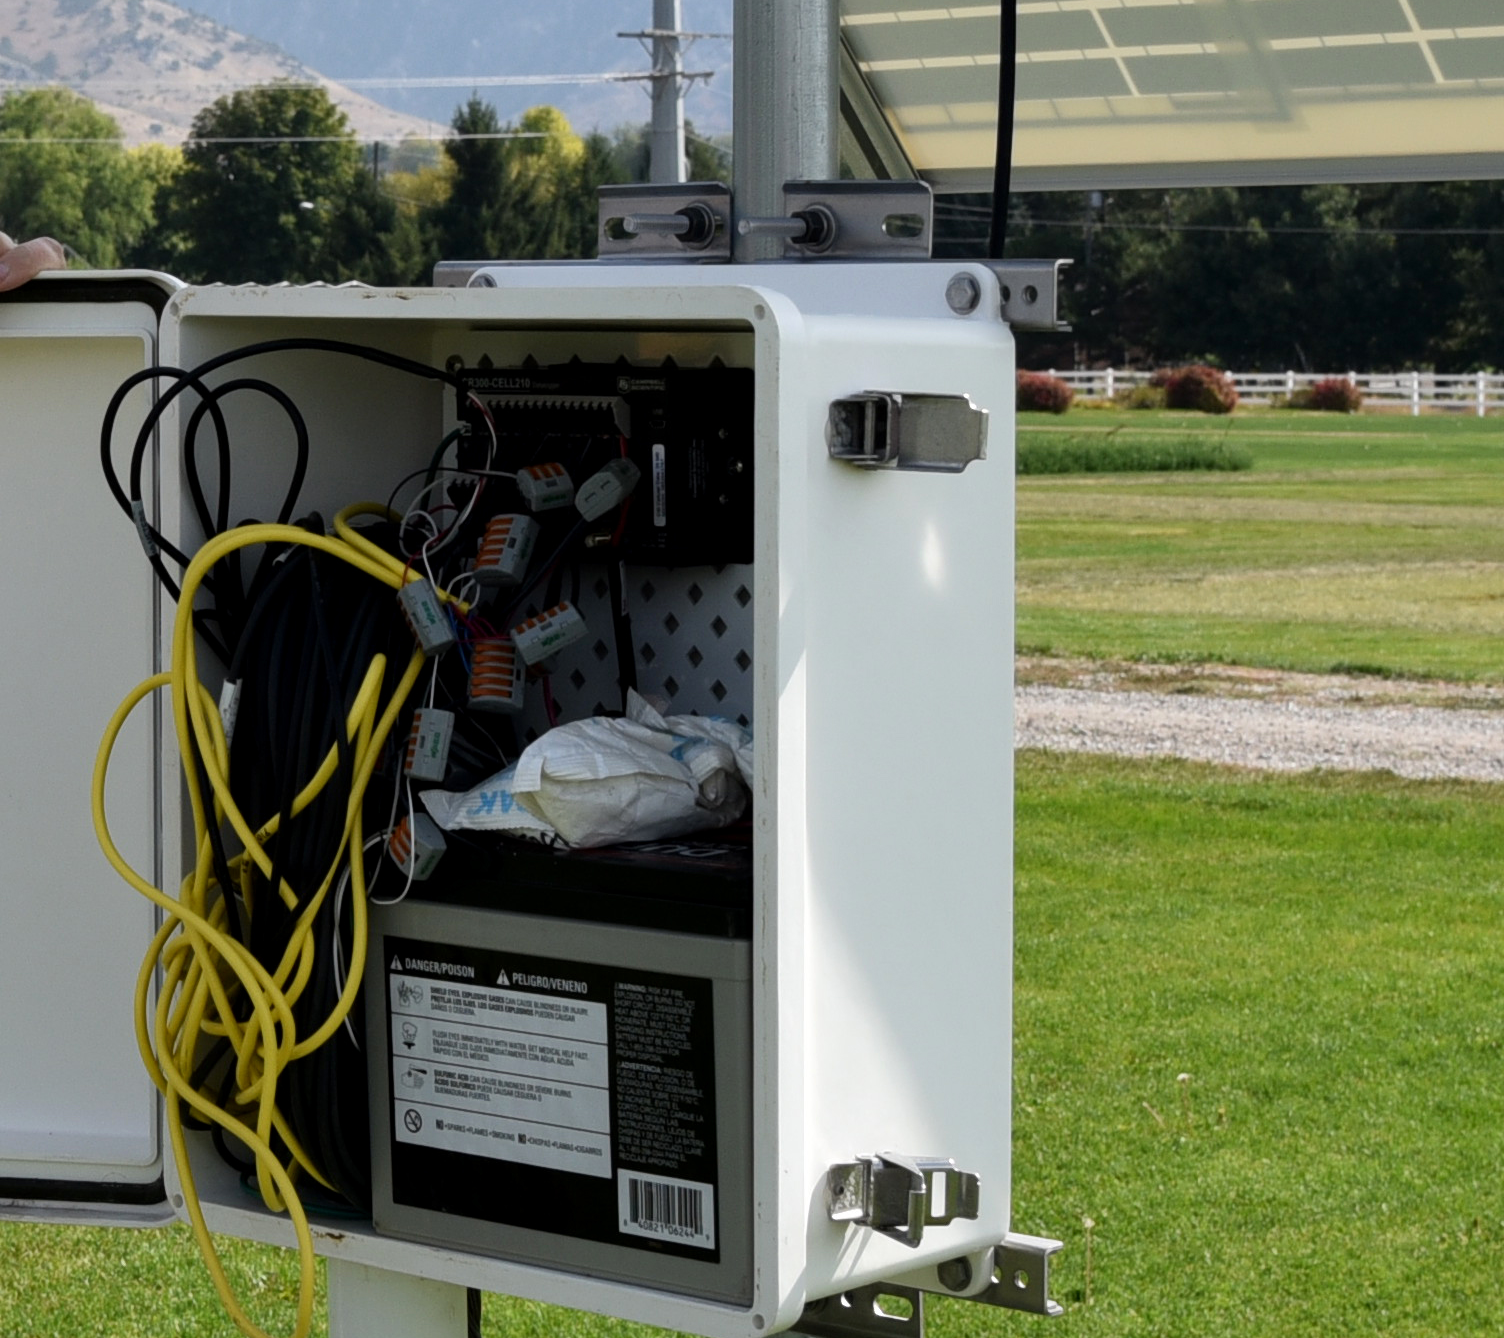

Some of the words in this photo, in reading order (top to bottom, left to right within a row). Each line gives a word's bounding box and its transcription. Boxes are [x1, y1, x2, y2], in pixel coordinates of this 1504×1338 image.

[405, 957, 475, 979] DANGER/POISON
[512, 972, 588, 994] PELIGRO/VENENO
[638, 1218, 665, 1233] 40821
[667, 1225, 695, 1239] 06244
